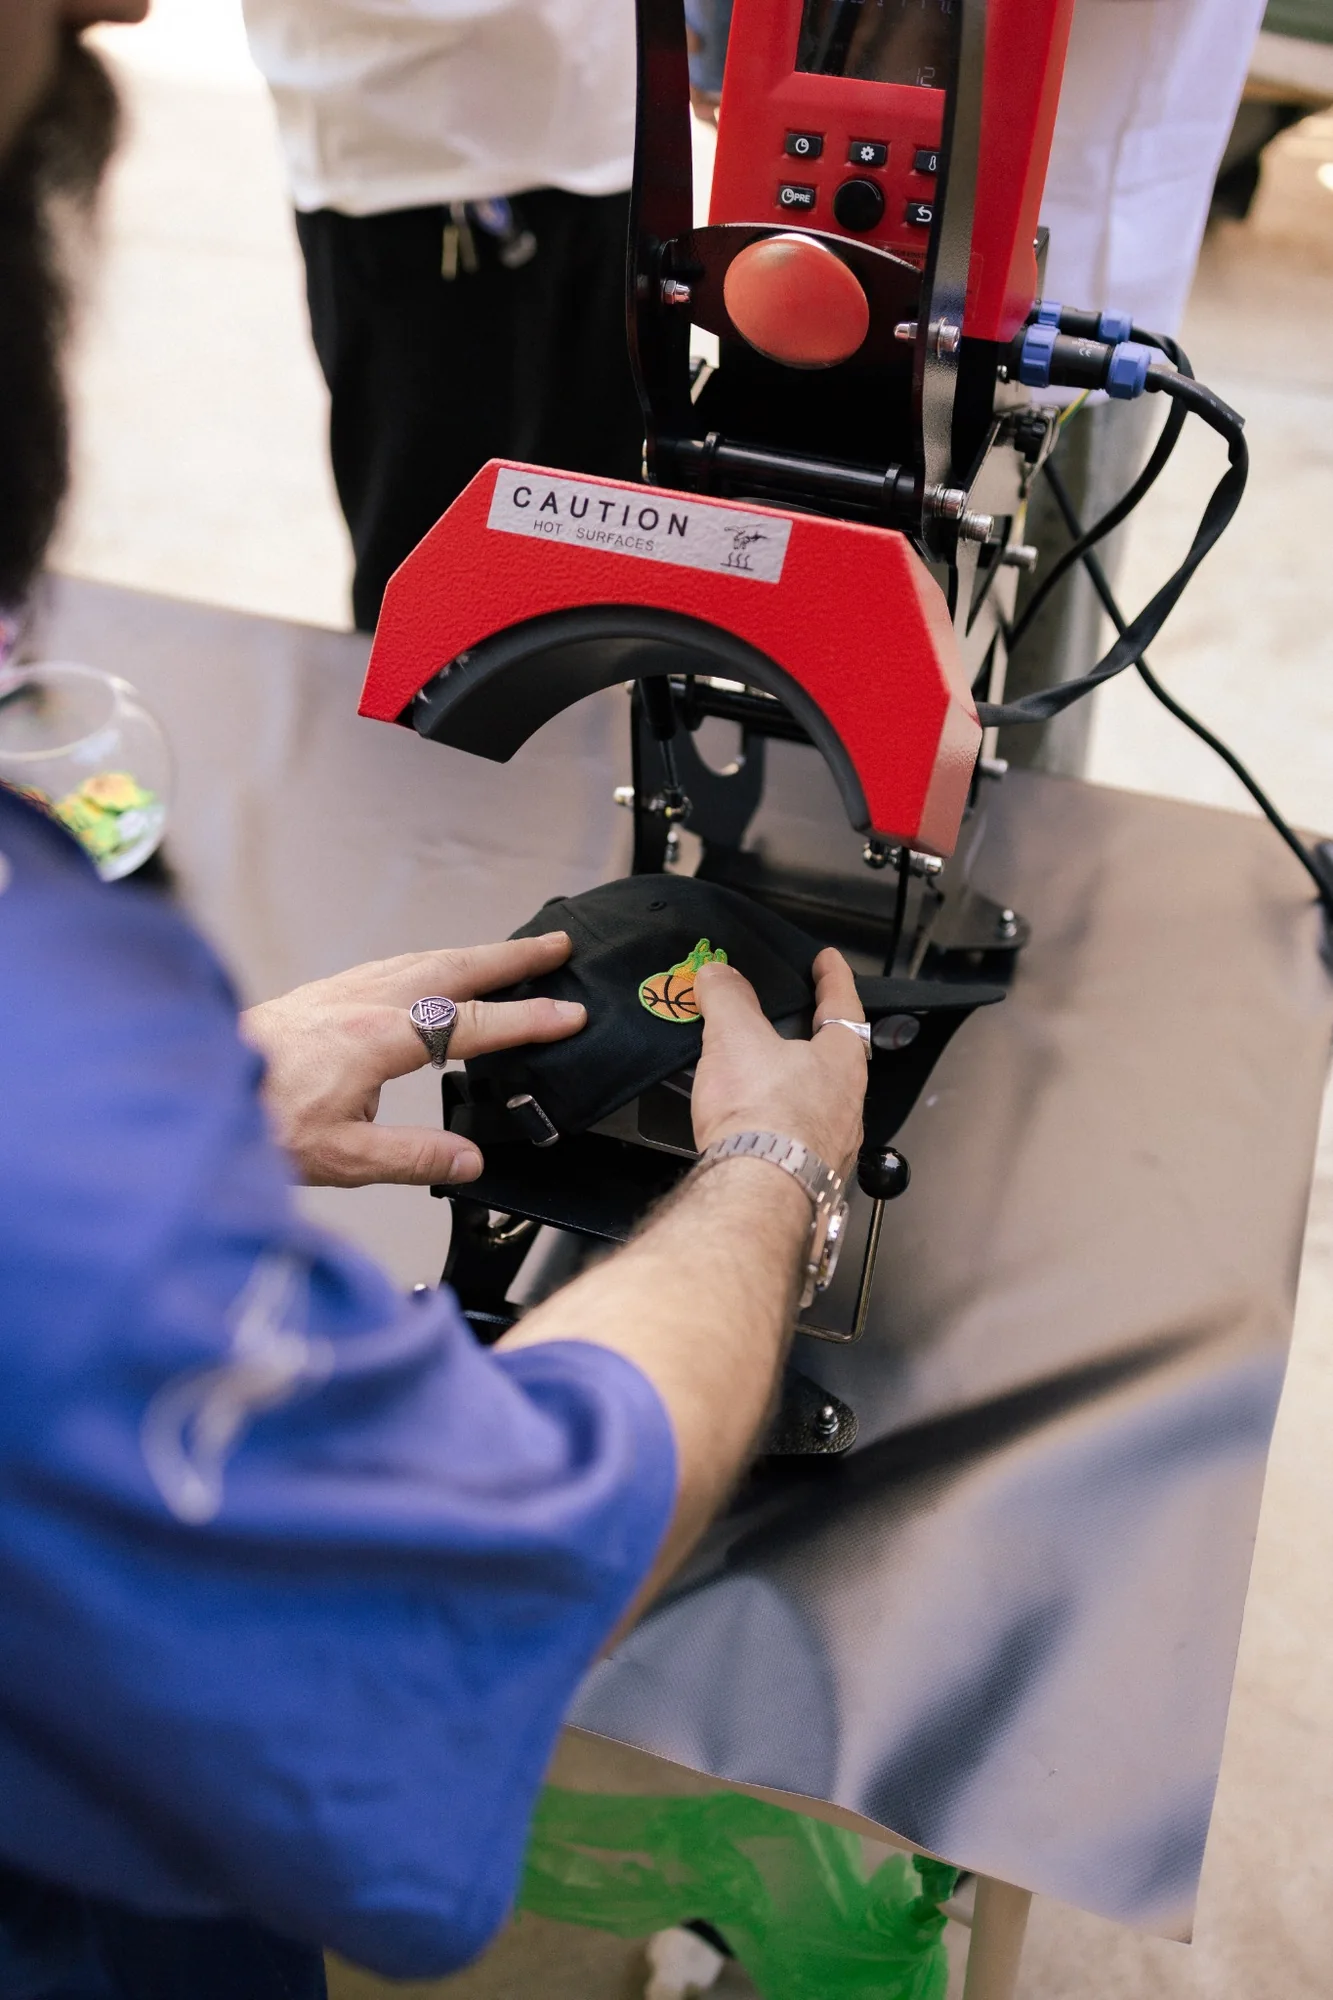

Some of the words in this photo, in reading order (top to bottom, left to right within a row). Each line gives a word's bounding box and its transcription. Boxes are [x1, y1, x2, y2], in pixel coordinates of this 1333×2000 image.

[794, 192, 811, 204] PRE
[513, 486, 689, 537] CAUTION
[533, 519, 563, 535] HOT
[576, 527, 654, 551] SURFACES
